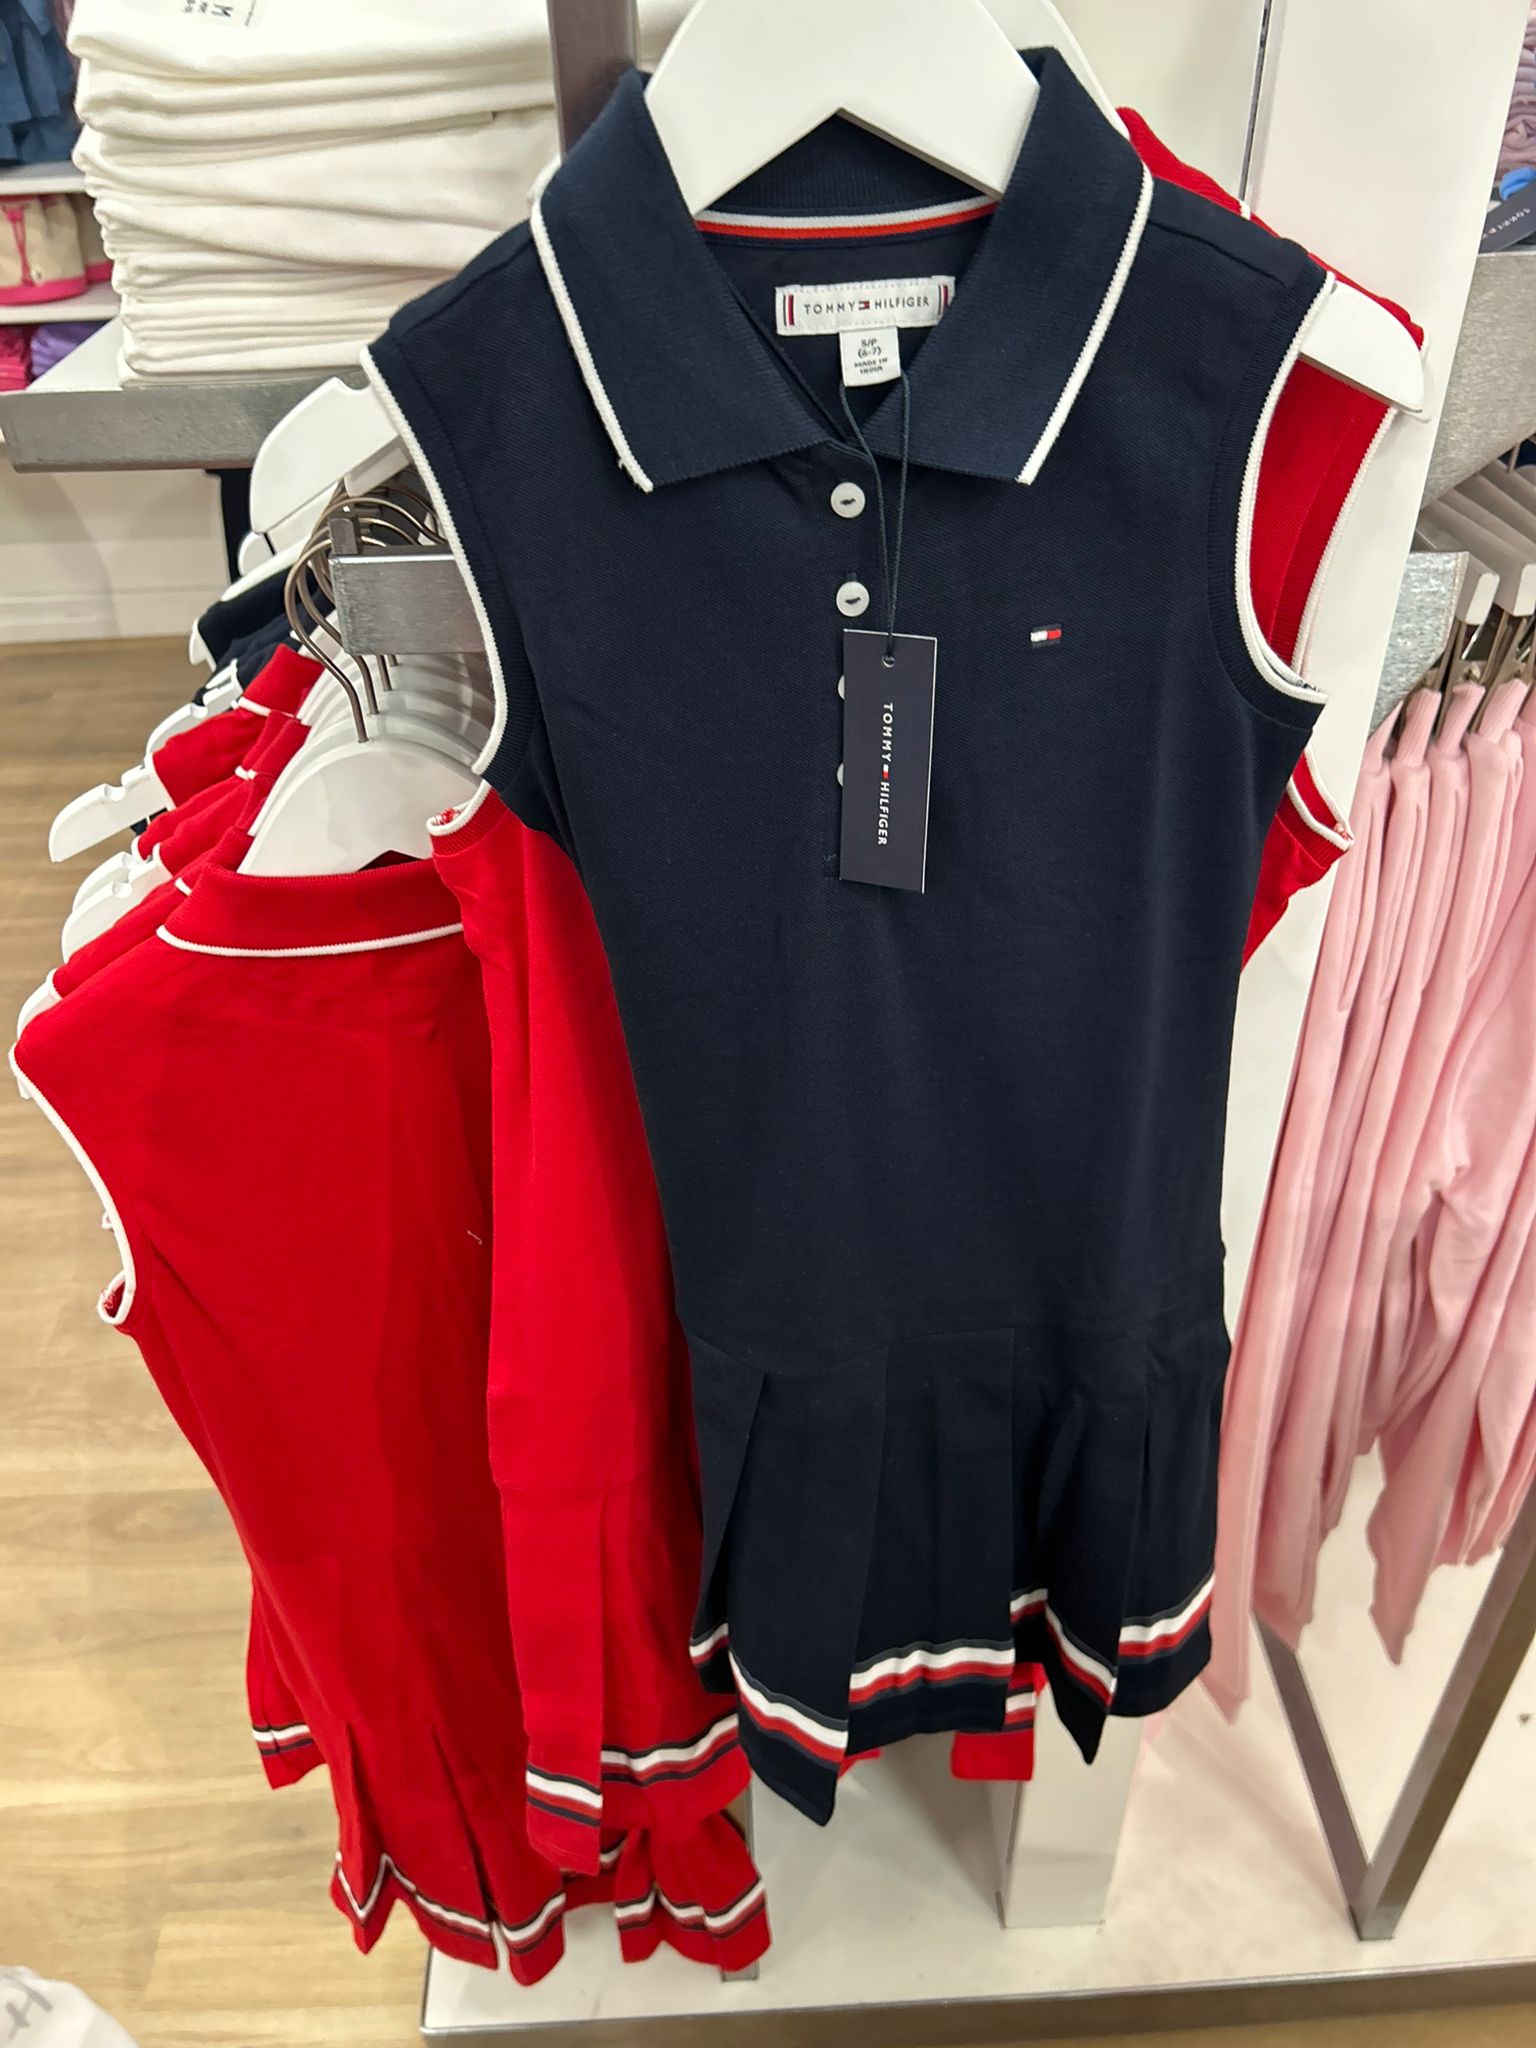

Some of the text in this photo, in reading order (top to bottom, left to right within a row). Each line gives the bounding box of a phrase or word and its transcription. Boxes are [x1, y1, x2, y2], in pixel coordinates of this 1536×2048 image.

[804, 296, 930, 315] TOMMY HILFIGER
[861, 338, 878, 348] S/P
[878, 702, 894, 845] TOMMY HILFIGER
